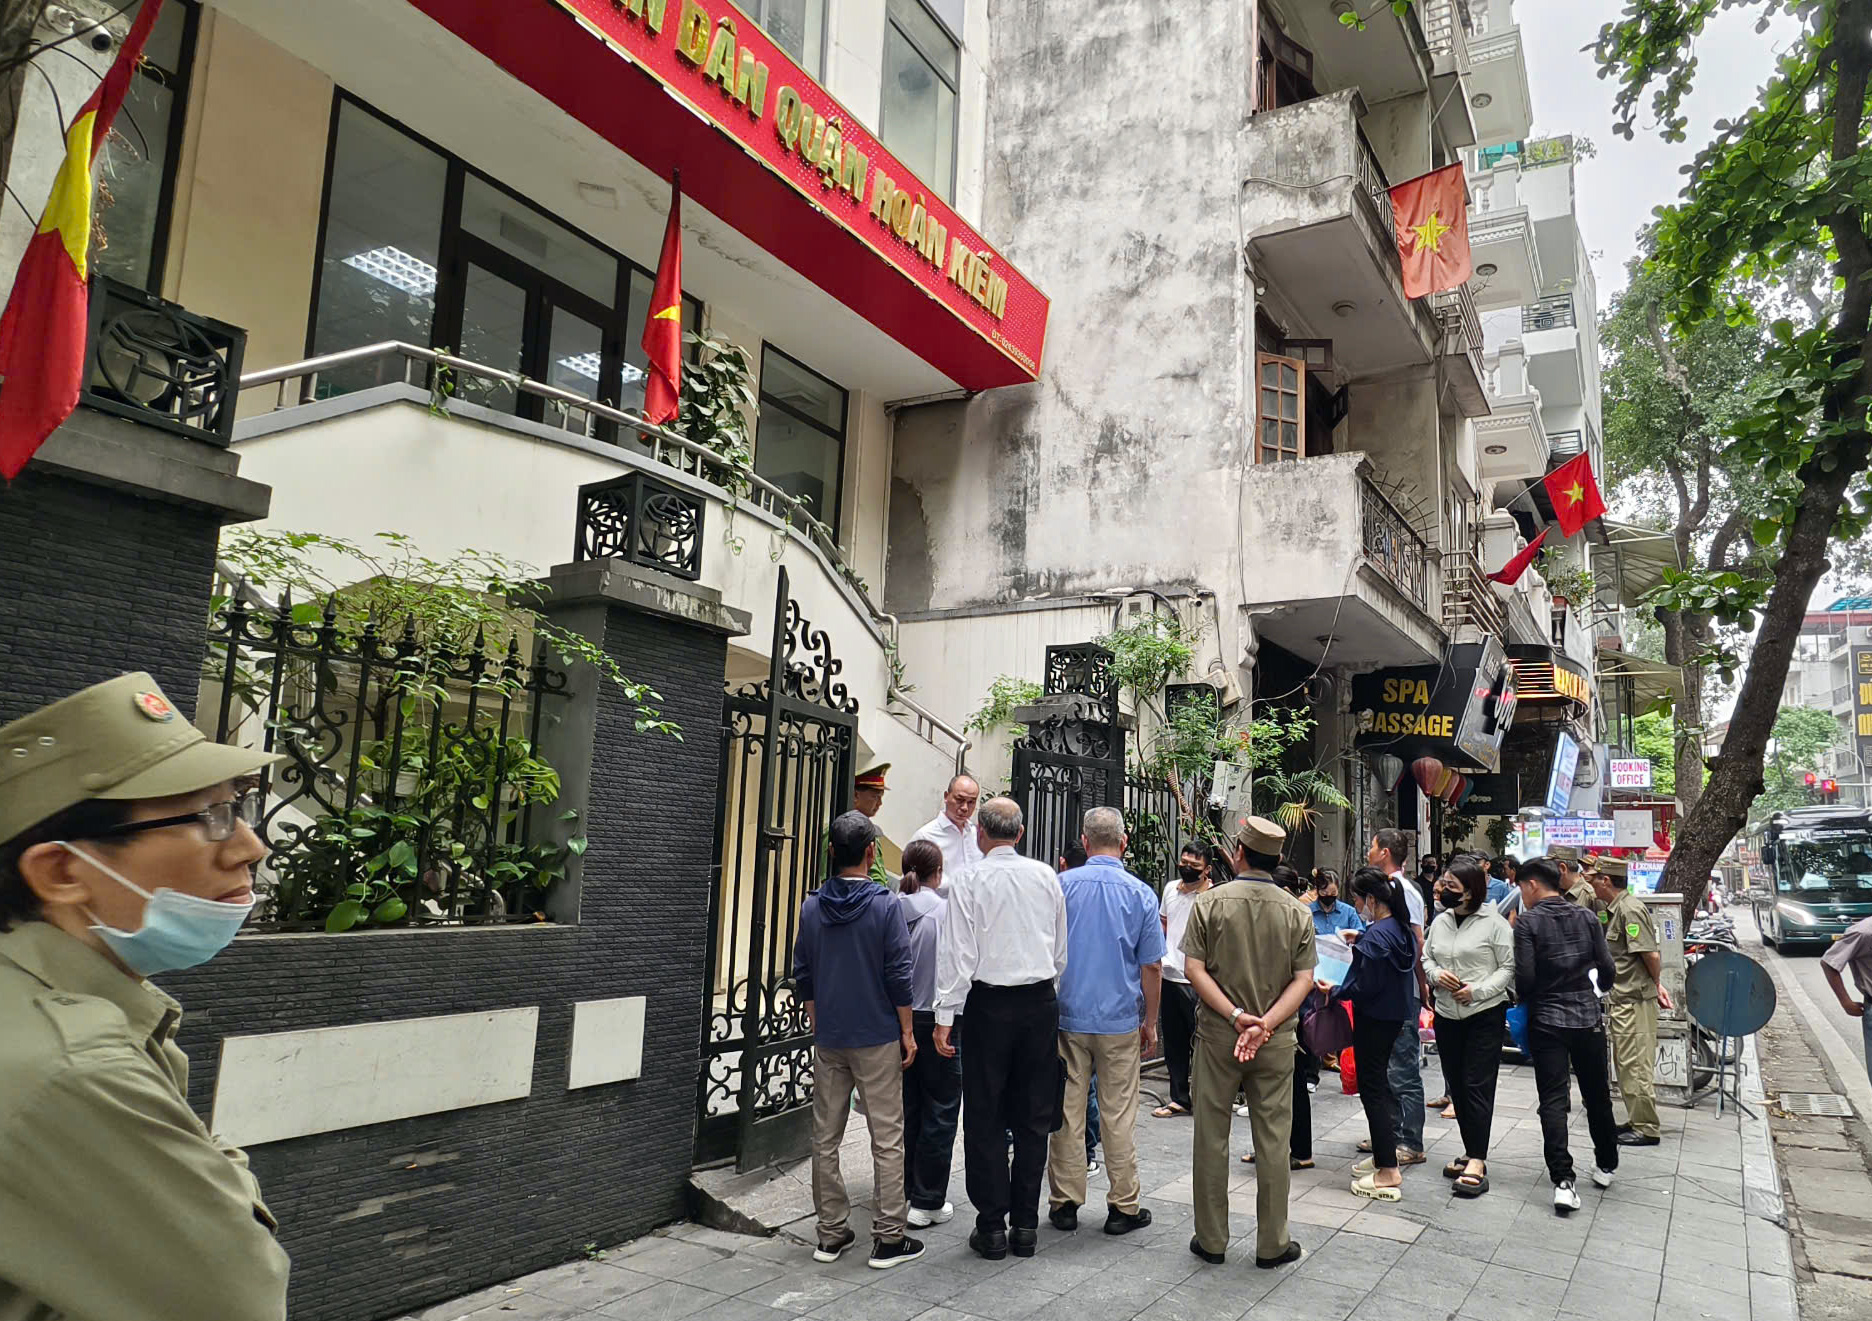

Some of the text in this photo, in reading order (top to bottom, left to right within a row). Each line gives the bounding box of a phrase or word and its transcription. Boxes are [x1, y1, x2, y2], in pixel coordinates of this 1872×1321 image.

[676, 0, 769, 119] DÂN
[775, 85, 869, 203] QUẬN
[869, 167, 947, 269] HOÀN
[947, 236, 1009, 321] KIẾM
[1382, 678, 1430, 705] SPA
[1612, 761, 1649, 773] BOOKING
[1617, 774, 1645, 785] OFFICE
